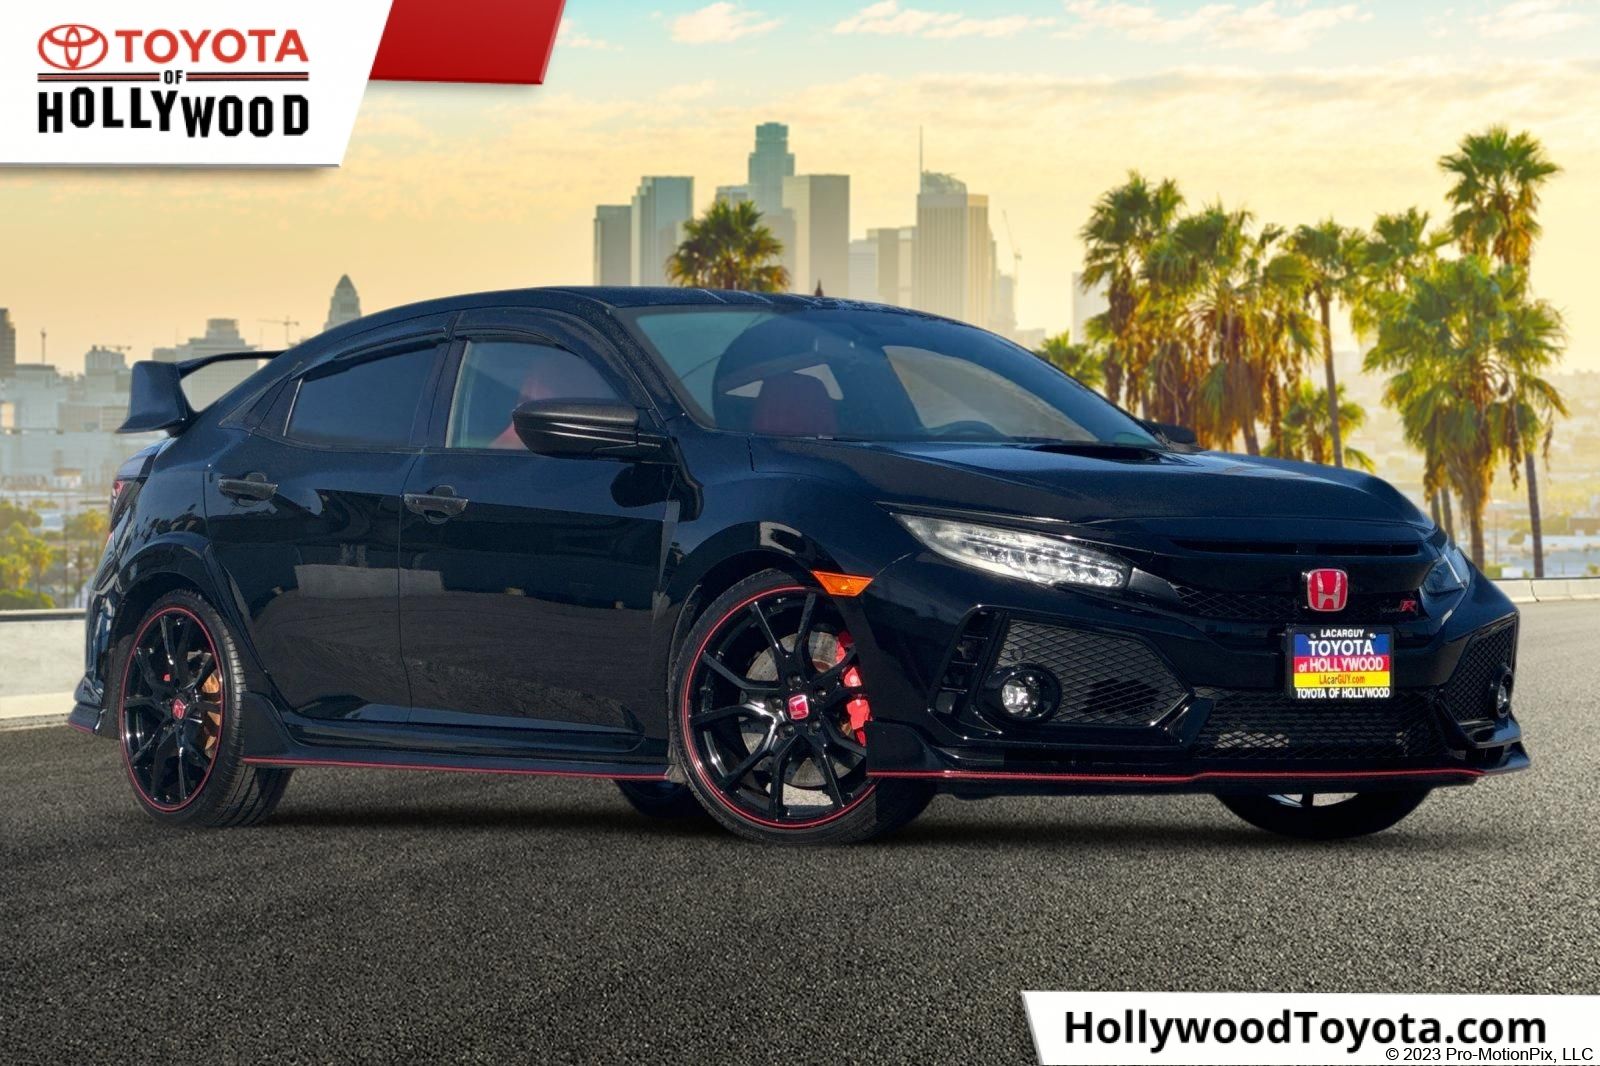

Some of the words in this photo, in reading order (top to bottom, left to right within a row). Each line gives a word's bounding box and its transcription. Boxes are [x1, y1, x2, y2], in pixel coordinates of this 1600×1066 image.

[1320, 629, 1365, 638] LACARGUY
[1308, 640, 1374, 656] TOYOTA
[1299, 661, 1308, 672] of
[1310, 657, 1384, 672] HOLLYWOOD
[1296, 687, 1327, 699] TOYOTA
[1329, 688, 1340, 698] OF
[1342, 688, 1390, 699] HOLLYWOOD
